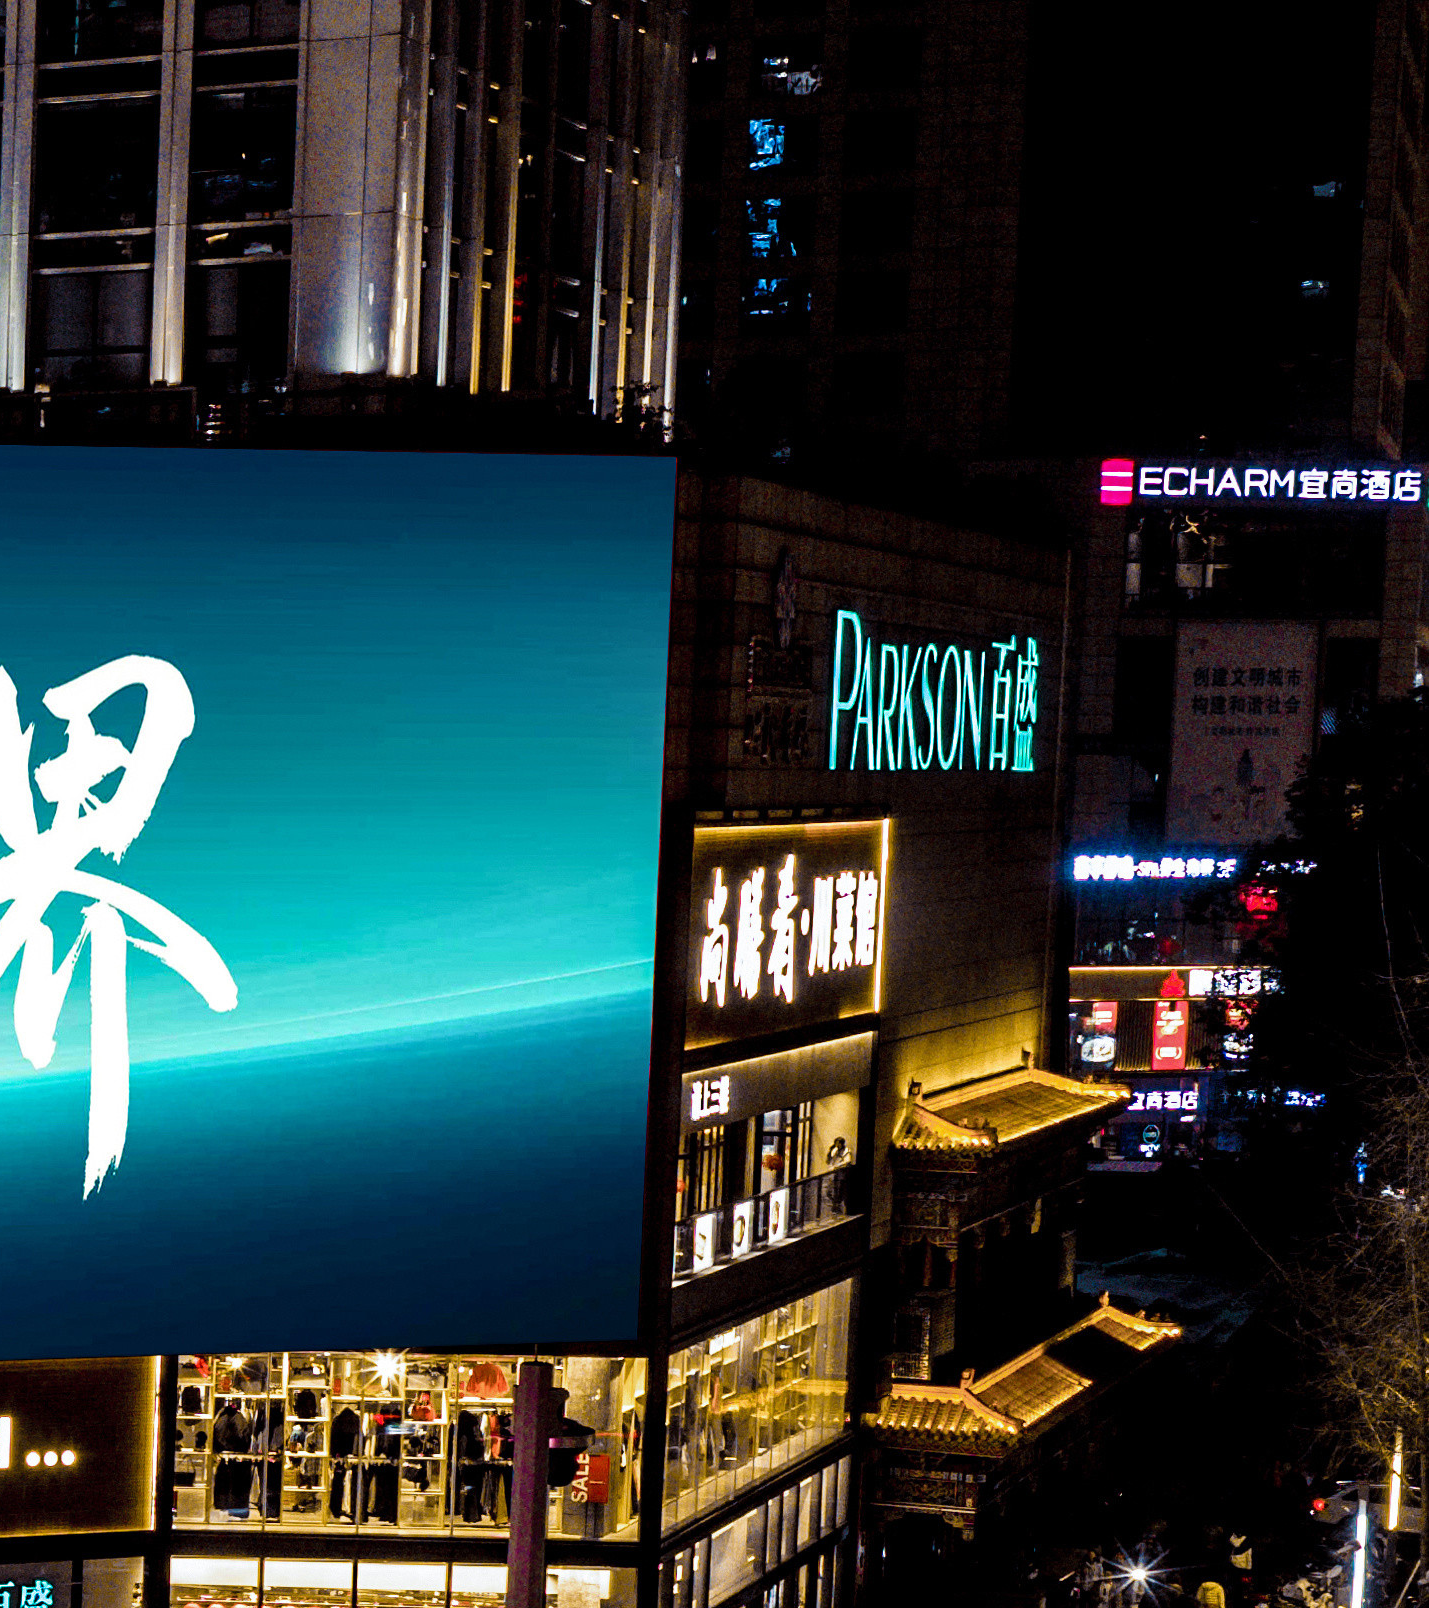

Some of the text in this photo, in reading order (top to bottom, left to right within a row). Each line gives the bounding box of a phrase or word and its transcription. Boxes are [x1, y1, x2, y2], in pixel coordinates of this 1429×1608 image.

[1140, 467, 1422, 501] ECHARM 宜尚酒店
[829, 610, 1039, 771] PARKSON 百盛
[571, 1453, 590, 1503] SALE
